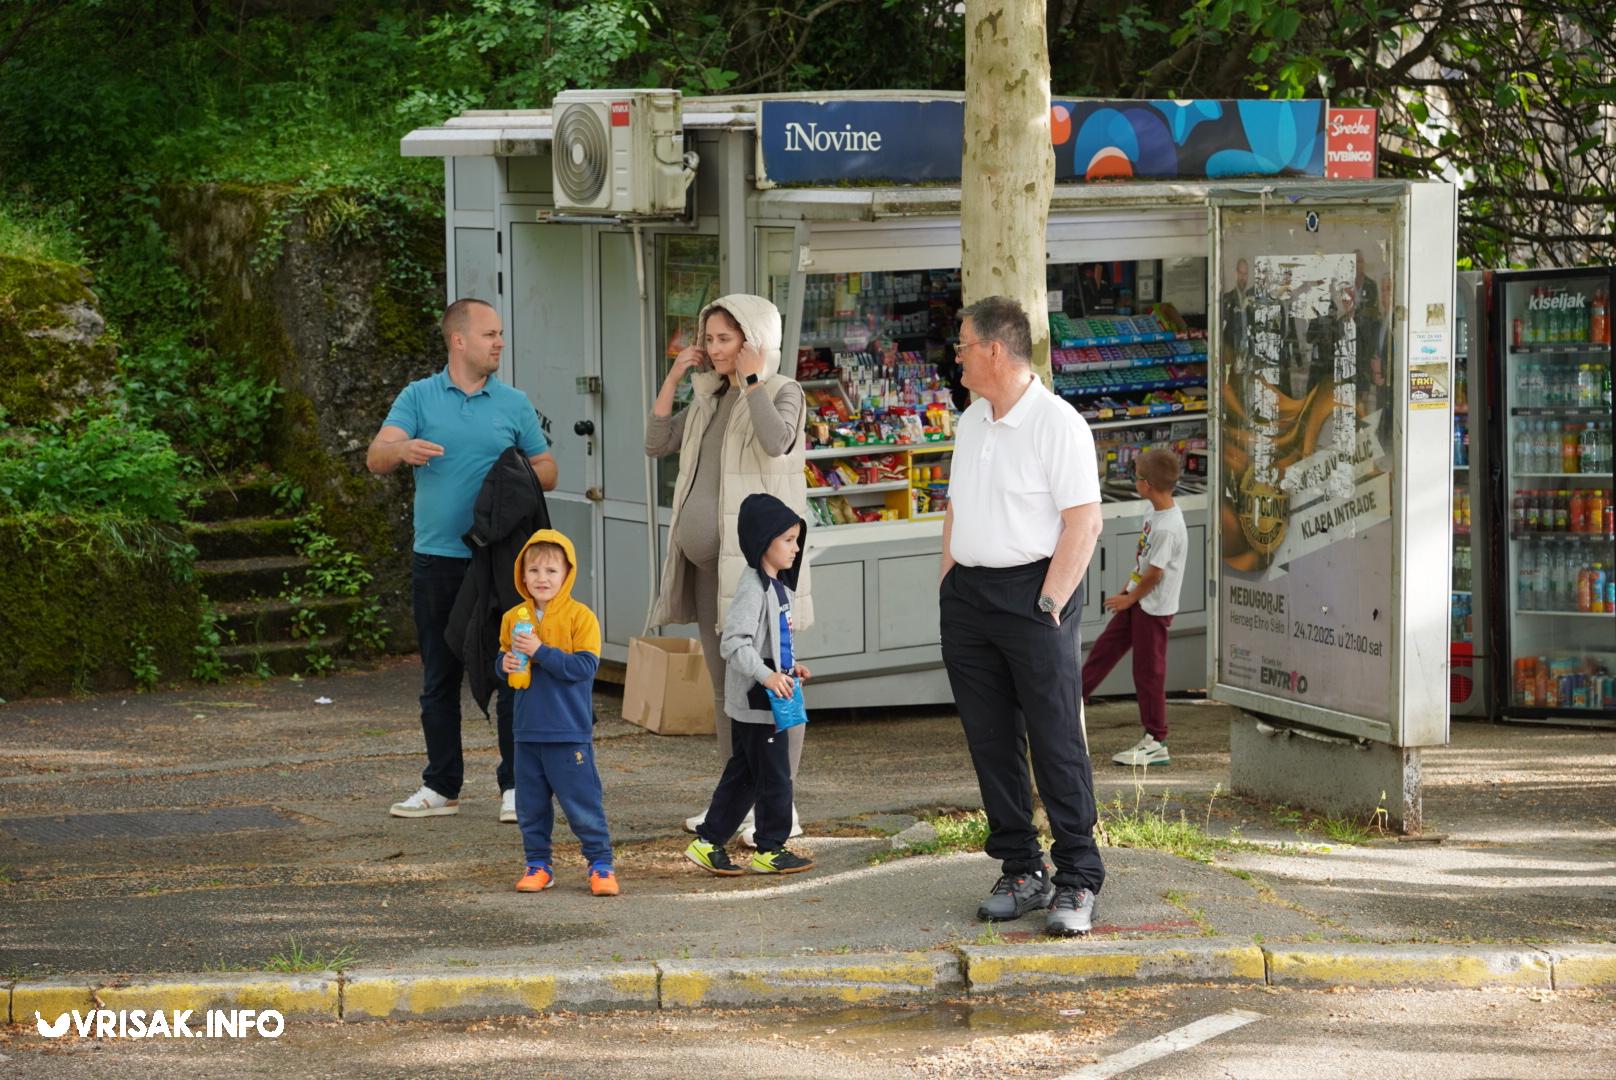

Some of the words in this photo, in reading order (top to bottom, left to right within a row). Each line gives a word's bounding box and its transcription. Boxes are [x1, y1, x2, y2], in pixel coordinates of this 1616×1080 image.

[611, 104, 629, 112] VIVAX
[785, 122, 881, 151] iNovine
[1528, 292, 1586, 311] kiseljak
[1411, 377, 1434, 386] TAXI
[1301, 510, 1334, 540] KLAPA
[1333, 491, 1377, 527] INTRADE
[1230, 585, 1285, 615] MEĐUGORJE
[1345, 632, 1368, 654] 21:00
[1369, 640, 1383, 657] sat
